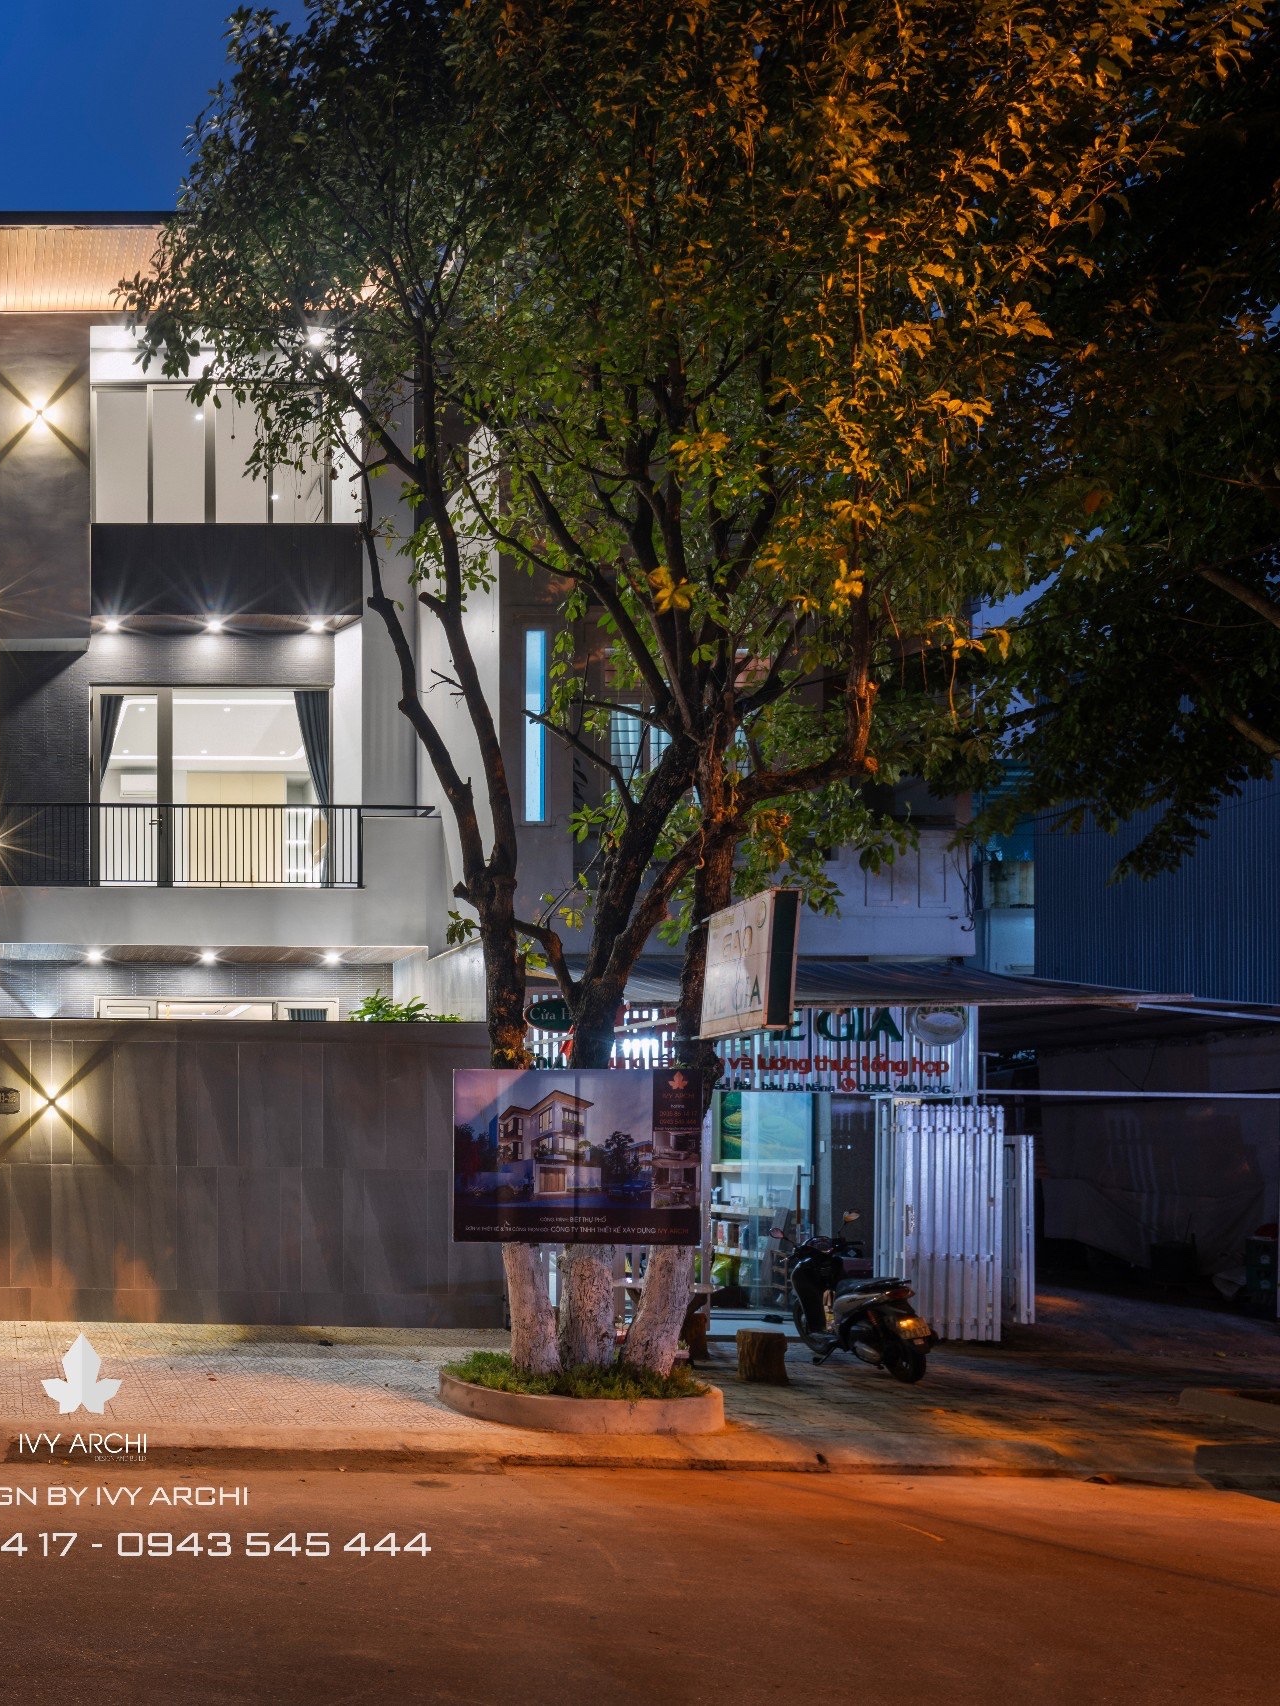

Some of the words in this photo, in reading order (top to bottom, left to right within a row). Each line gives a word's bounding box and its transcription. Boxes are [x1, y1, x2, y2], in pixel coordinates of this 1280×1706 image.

[529, 1007, 556, 1021] Cửa
[816, 1007, 904, 1042] GIA
[727, 1053, 754, 1070] và
[757, 1053, 812, 1075] lương
[813, 1054, 857, 1076] thực
[861, 1053, 908, 1077] tổng
[911, 1056, 950, 1078] hợp
